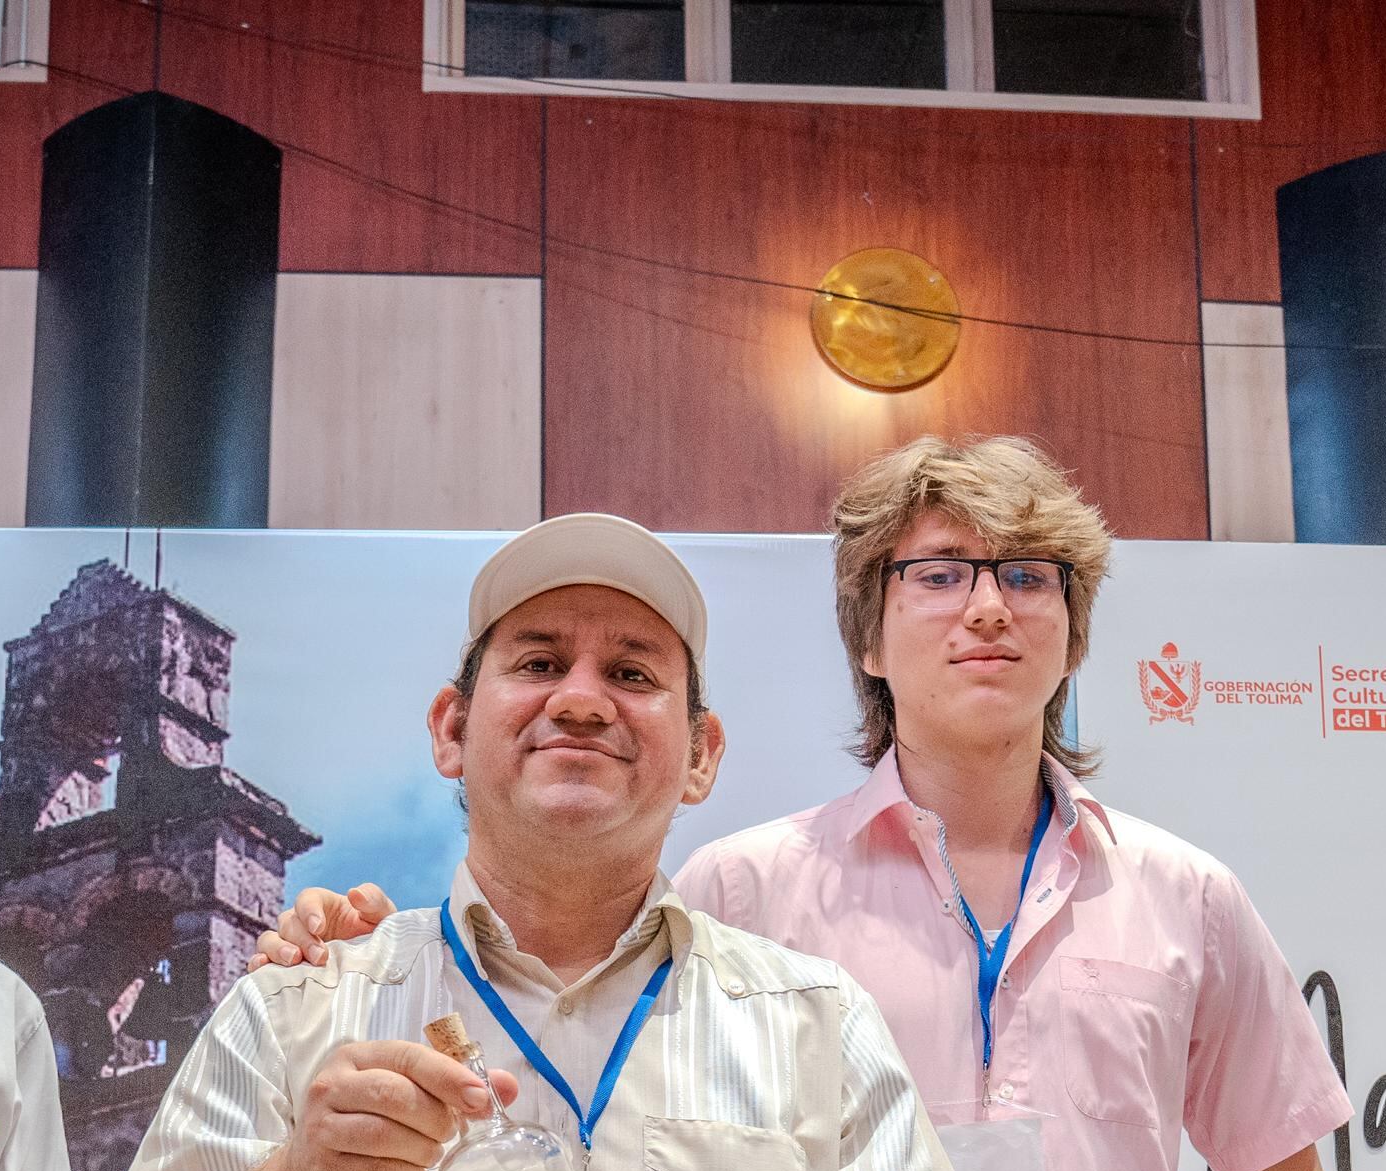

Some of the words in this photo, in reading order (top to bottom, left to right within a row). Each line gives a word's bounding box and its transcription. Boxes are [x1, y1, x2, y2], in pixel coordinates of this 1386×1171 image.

[1204, 680, 1313, 694] GOBERNACIÓN
[1215, 693, 1243, 704] DEL
[1246, 693, 1303, 704] TOLIMA
[1336, 709, 1370, 728] del
